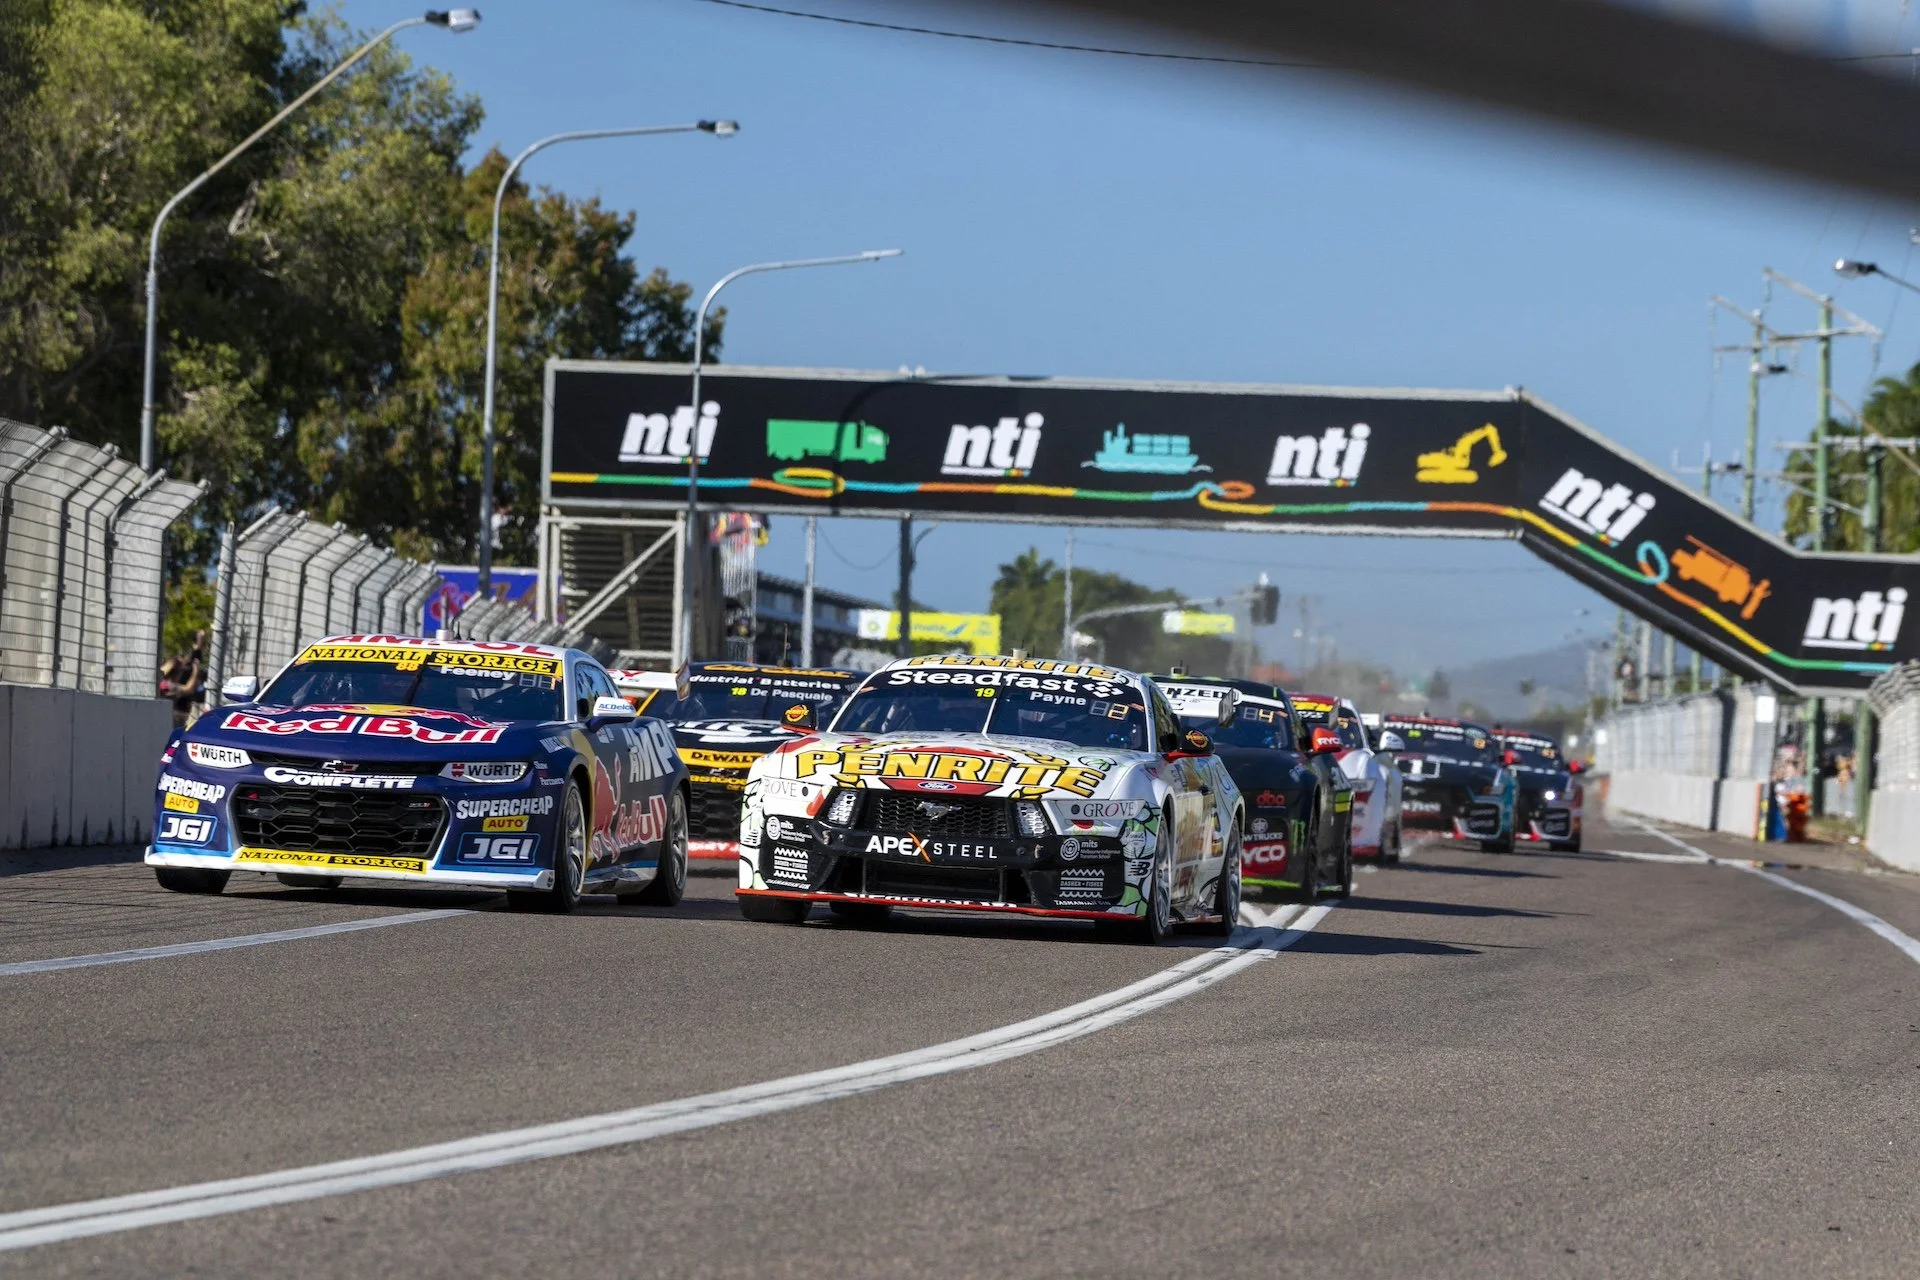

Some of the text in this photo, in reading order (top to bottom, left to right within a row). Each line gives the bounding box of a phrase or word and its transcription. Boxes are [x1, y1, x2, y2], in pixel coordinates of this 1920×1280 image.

[621, 401, 721, 458] nti
[945, 412, 1045, 470] nti
[1270, 423, 1371, 479] nti
[1544, 468, 1656, 542] nti
[1805, 587, 1908, 643] nti
[323, 635, 555, 657] AMOL
[306, 648, 553, 672] NATIONAL STORAGE
[395, 662, 418, 671] 88
[440, 666, 515, 681] Feeney
[689, 674, 754, 685] dustrial
[760, 677, 841, 690] Batteries
[888, 671, 1079, 694] Steadfast
[730, 687, 833, 701] 18 De Pasquale
[975, 688, 996, 698] 19
[1030, 691, 1087, 706] Payne
[221, 712, 508, 744] Red Bull
[1317, 736, 1341, 745] RYC
[264, 766, 417, 789] COMPLETE
[797, 750, 1107, 798] PENRITE
[763, 778, 797, 798] ROVE
[168, 797, 195, 808] AUTO
[456, 796, 553, 819] SUPERCHEAP
[1083, 802, 1135, 818] GROVE
[160, 817, 212, 842] JGI
[488, 820, 523, 828] AUTO
[464, 838, 533, 860] JGI
[865, 833, 998, 860] APEX STEEL
[1081, 840, 1098, 848] mits
[1242, 845, 1286, 865] YCO
[240, 850, 420, 870] NATIONAL STORAGE
